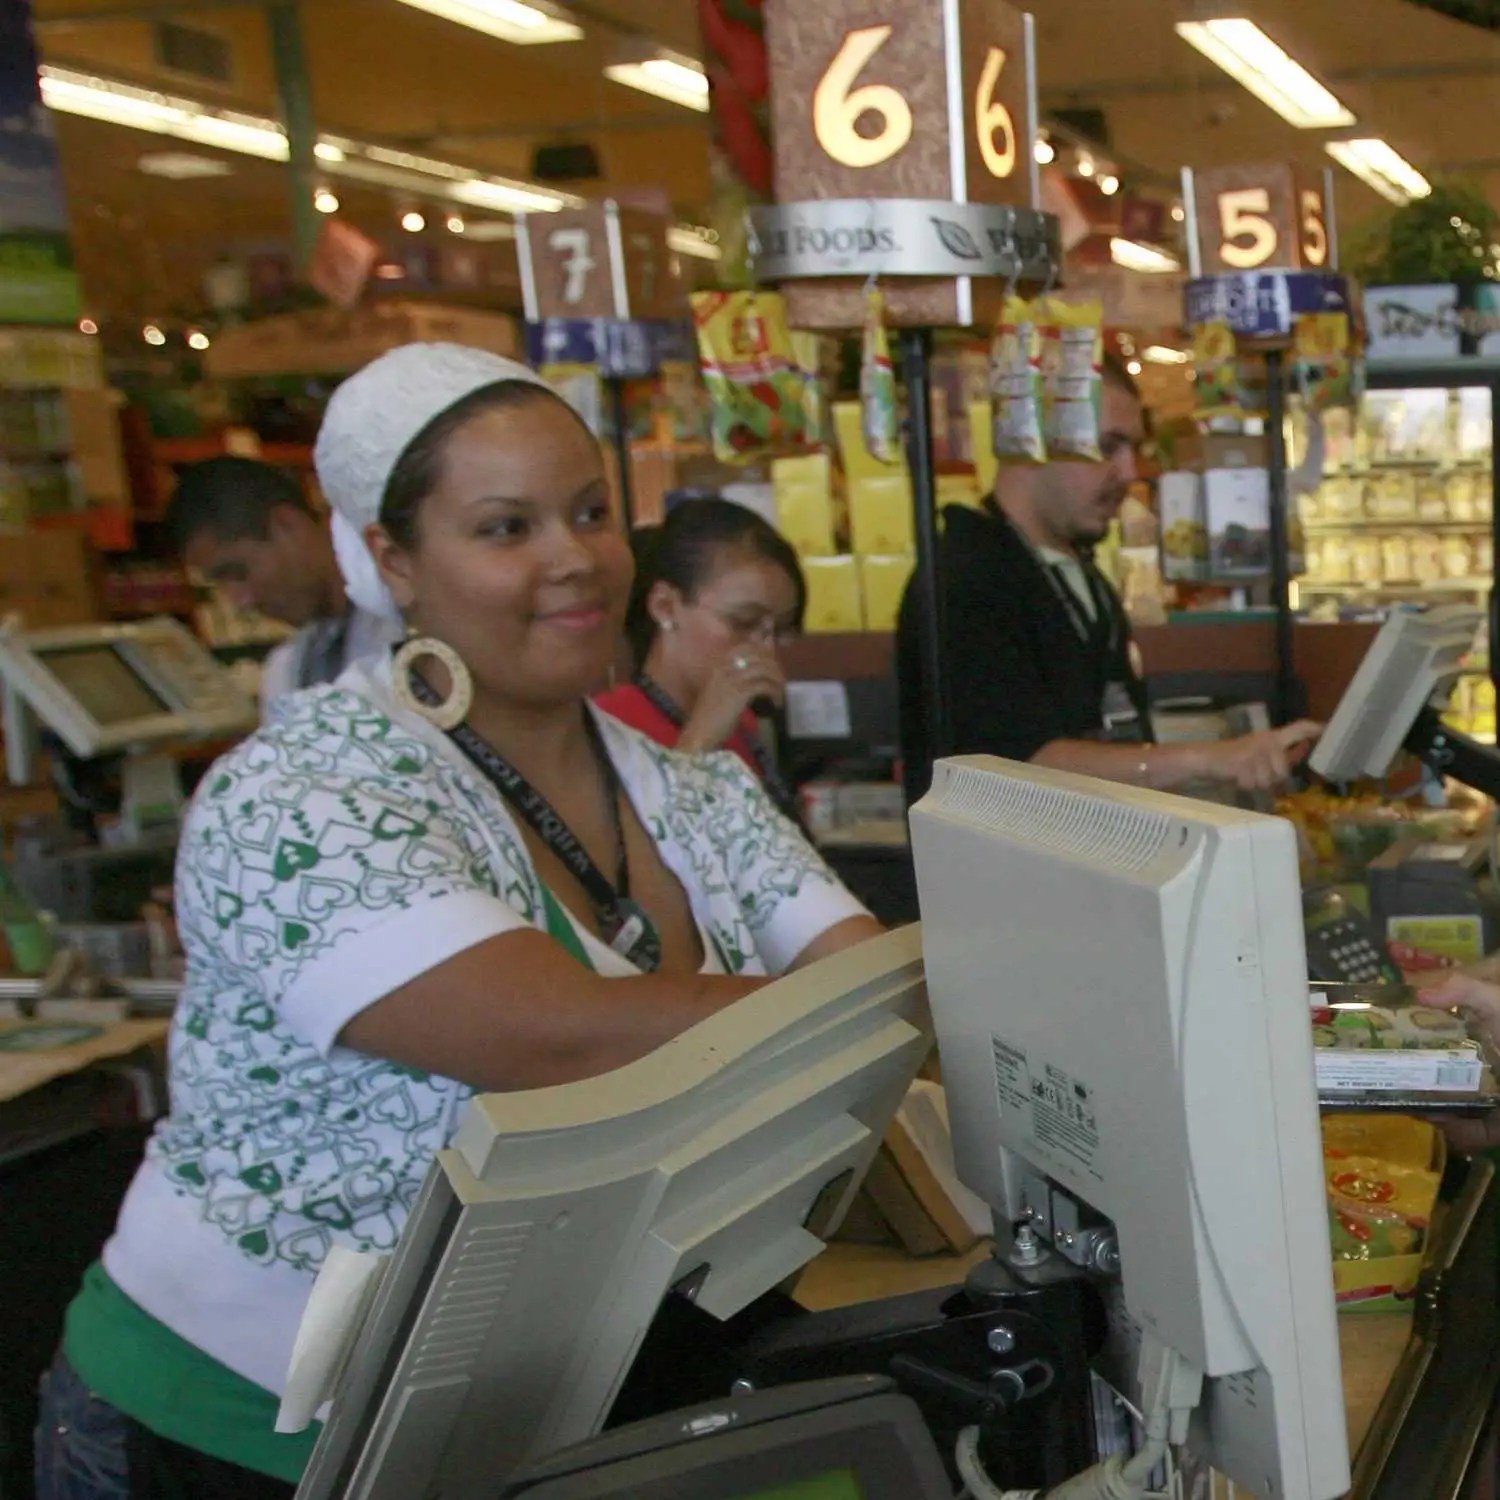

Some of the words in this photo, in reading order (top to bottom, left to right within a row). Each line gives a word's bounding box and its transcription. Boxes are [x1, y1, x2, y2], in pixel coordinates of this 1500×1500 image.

[813, 25, 912, 168] 6
[974, 46, 1017, 179] 6
[551, 229, 597, 305] 7
[1218, 187, 1277, 269] 5
[1301, 189, 1327, 267] 5
